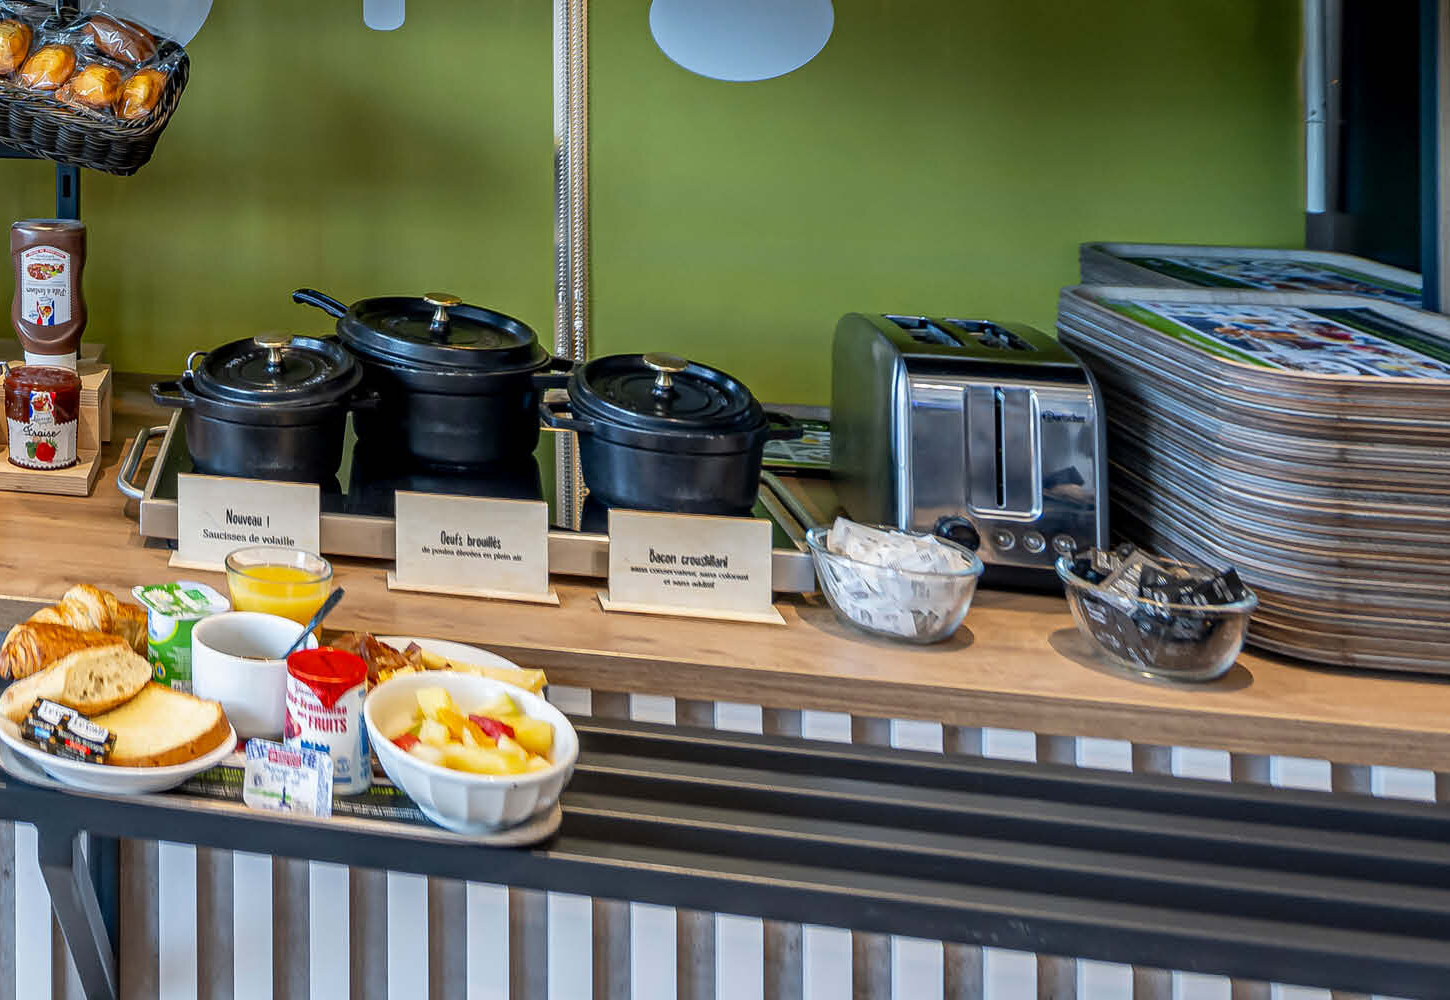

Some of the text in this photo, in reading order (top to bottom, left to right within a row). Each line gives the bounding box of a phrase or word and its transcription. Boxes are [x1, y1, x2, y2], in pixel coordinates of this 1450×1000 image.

[23, 423, 61, 438] Fraise
[225, 508, 263, 527] Nouveau
[202, 529, 295, 546] Saucisses de volaille
[467, 533, 501, 550] brouillés
[649, 548, 677, 564] Bacon
[309, 715, 347, 734] FRUITS
